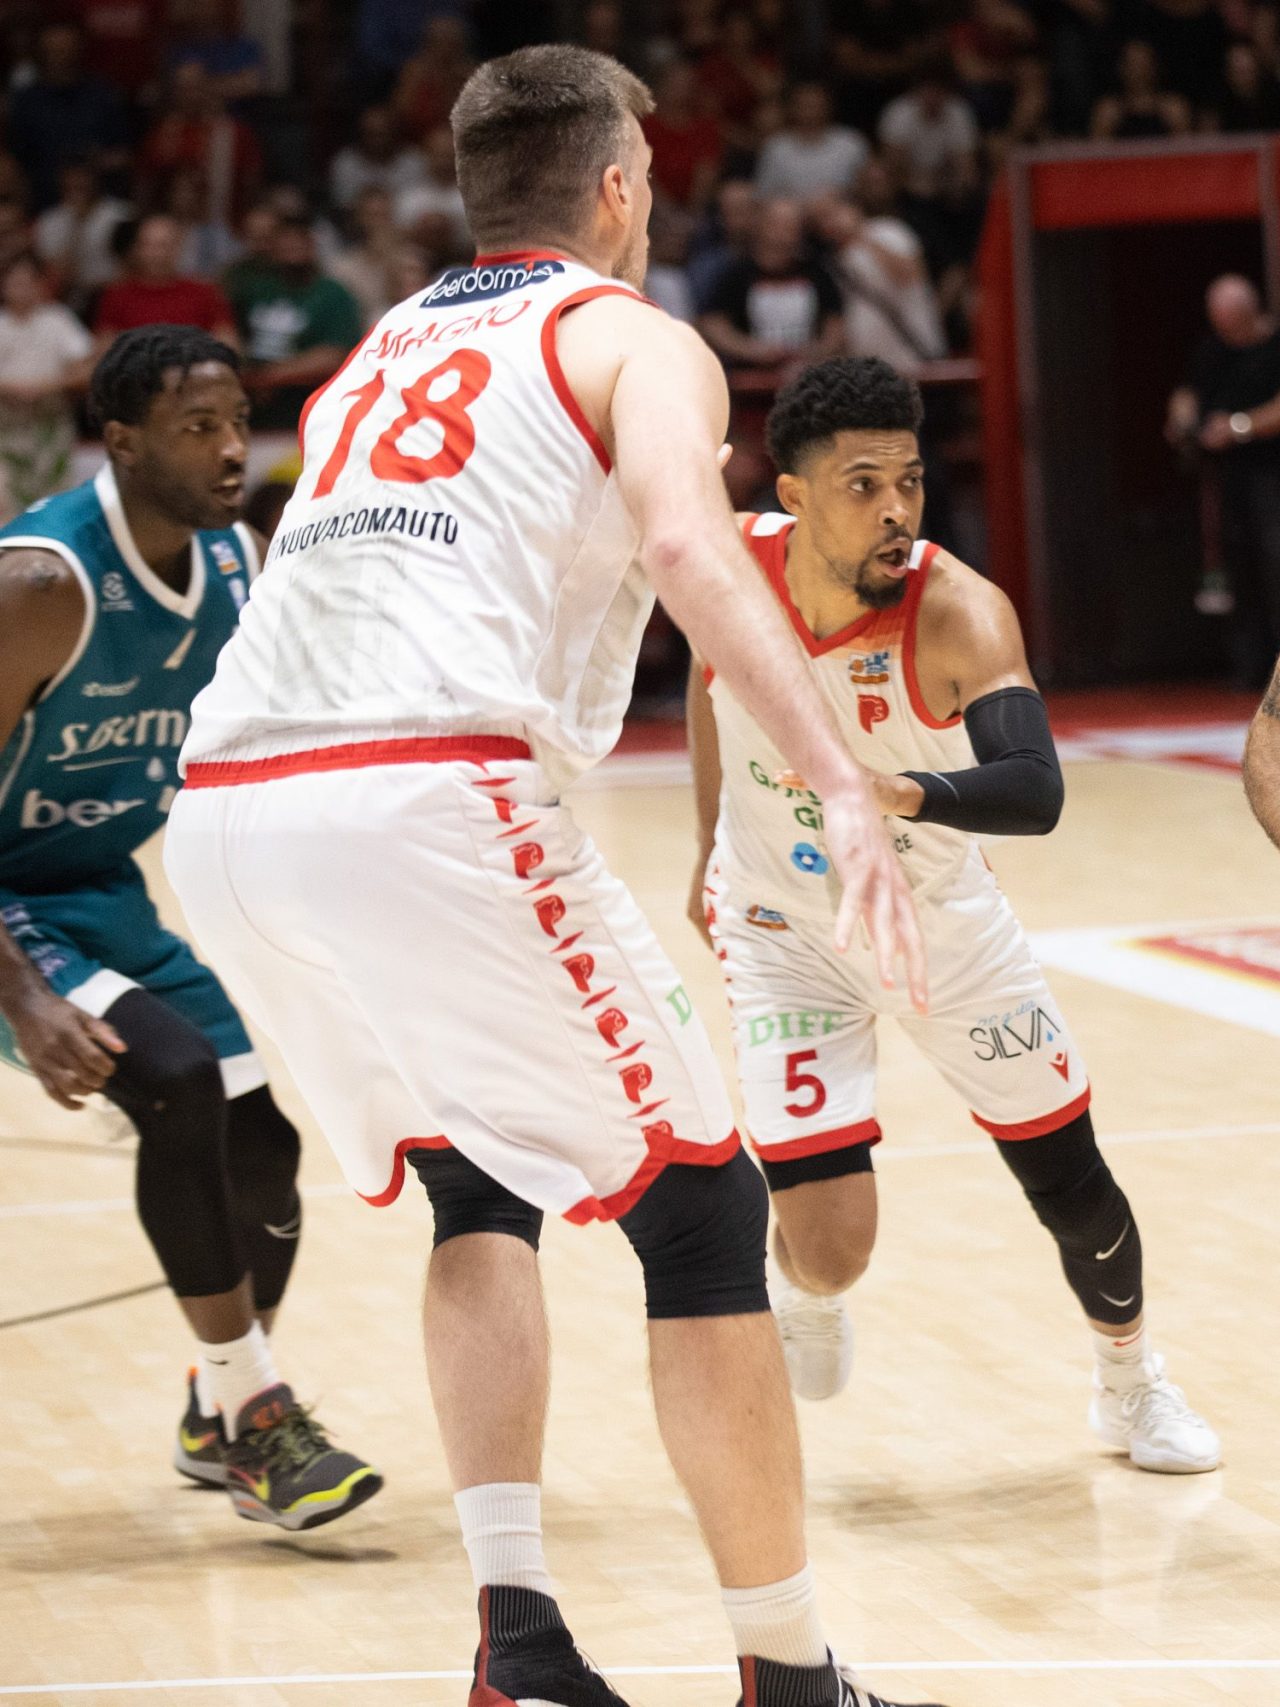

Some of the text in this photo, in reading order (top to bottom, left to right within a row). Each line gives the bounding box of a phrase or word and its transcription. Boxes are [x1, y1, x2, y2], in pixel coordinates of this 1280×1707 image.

[311, 348, 492, 500] 18
[276, 506, 459, 560] NUOVACOMAUTO
[969, 1007, 1062, 1061] SILVA
[783, 1048, 828, 1119] 5
